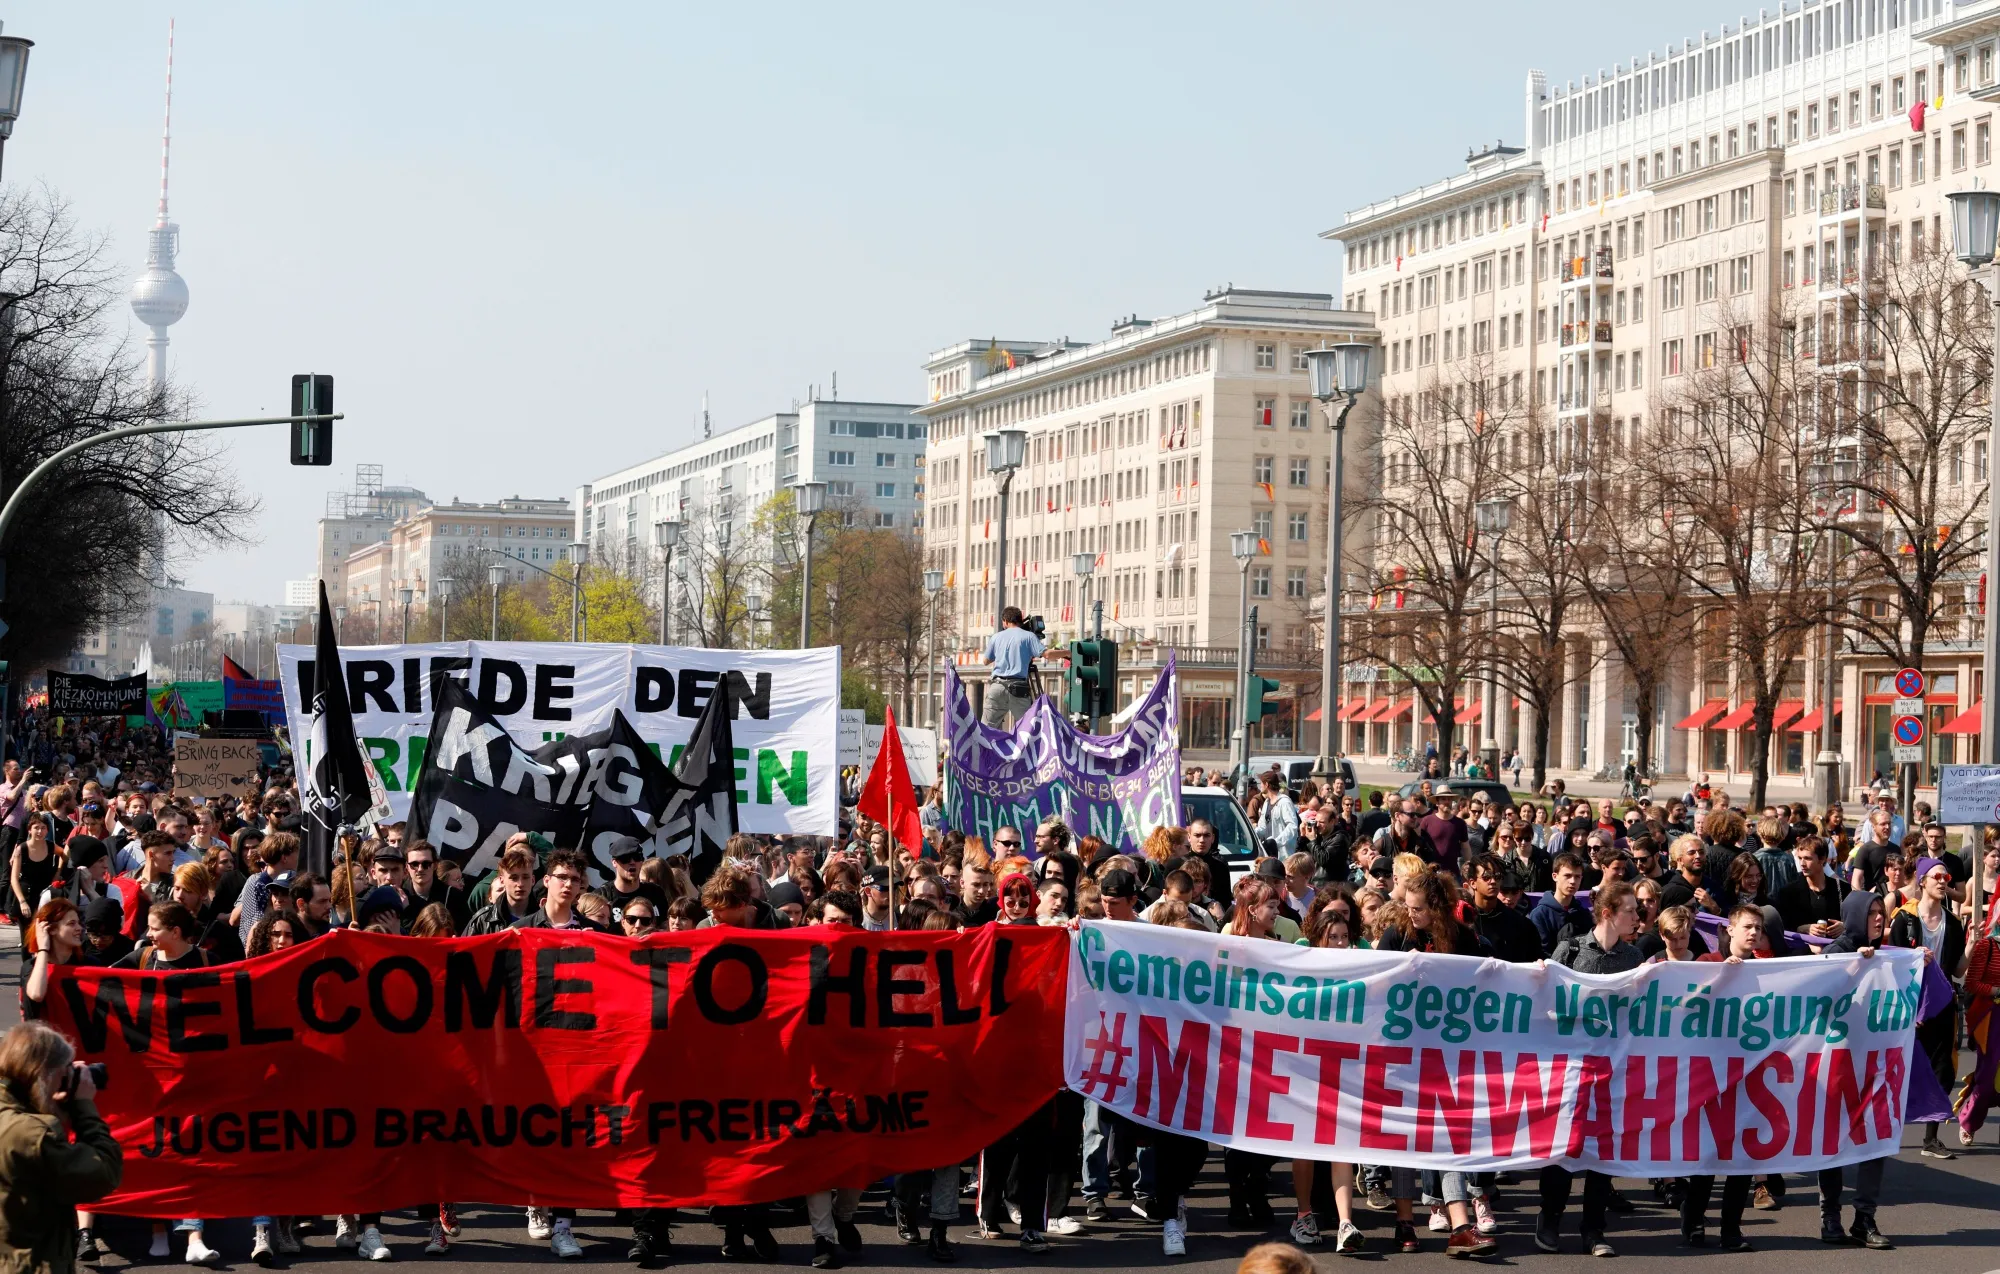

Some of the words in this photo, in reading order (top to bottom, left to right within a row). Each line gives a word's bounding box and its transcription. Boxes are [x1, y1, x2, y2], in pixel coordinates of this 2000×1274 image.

[55, 677, 71, 687] DIE
[634, 664, 772, 721] DEN
[176, 745, 219, 760] BRING
[222, 745, 254, 760] BACK
[205, 762, 220, 772] MY
[1126, 778, 1142, 797] 34
[973, 794, 1041, 851] HAM
[61, 945, 598, 1054] WELCOME
[630, 943, 770, 1031] TO
[1080, 926, 1366, 1025] Gemeinsam
[1381, 979, 1534, 1044] gegen
[1555, 979, 1858, 1051] Verdrängung
[139, 1107, 357, 1158] JUGEND
[374, 1103, 631, 1148] BRAUCHT
[647, 1087, 929, 1146] FREIRÄUME
